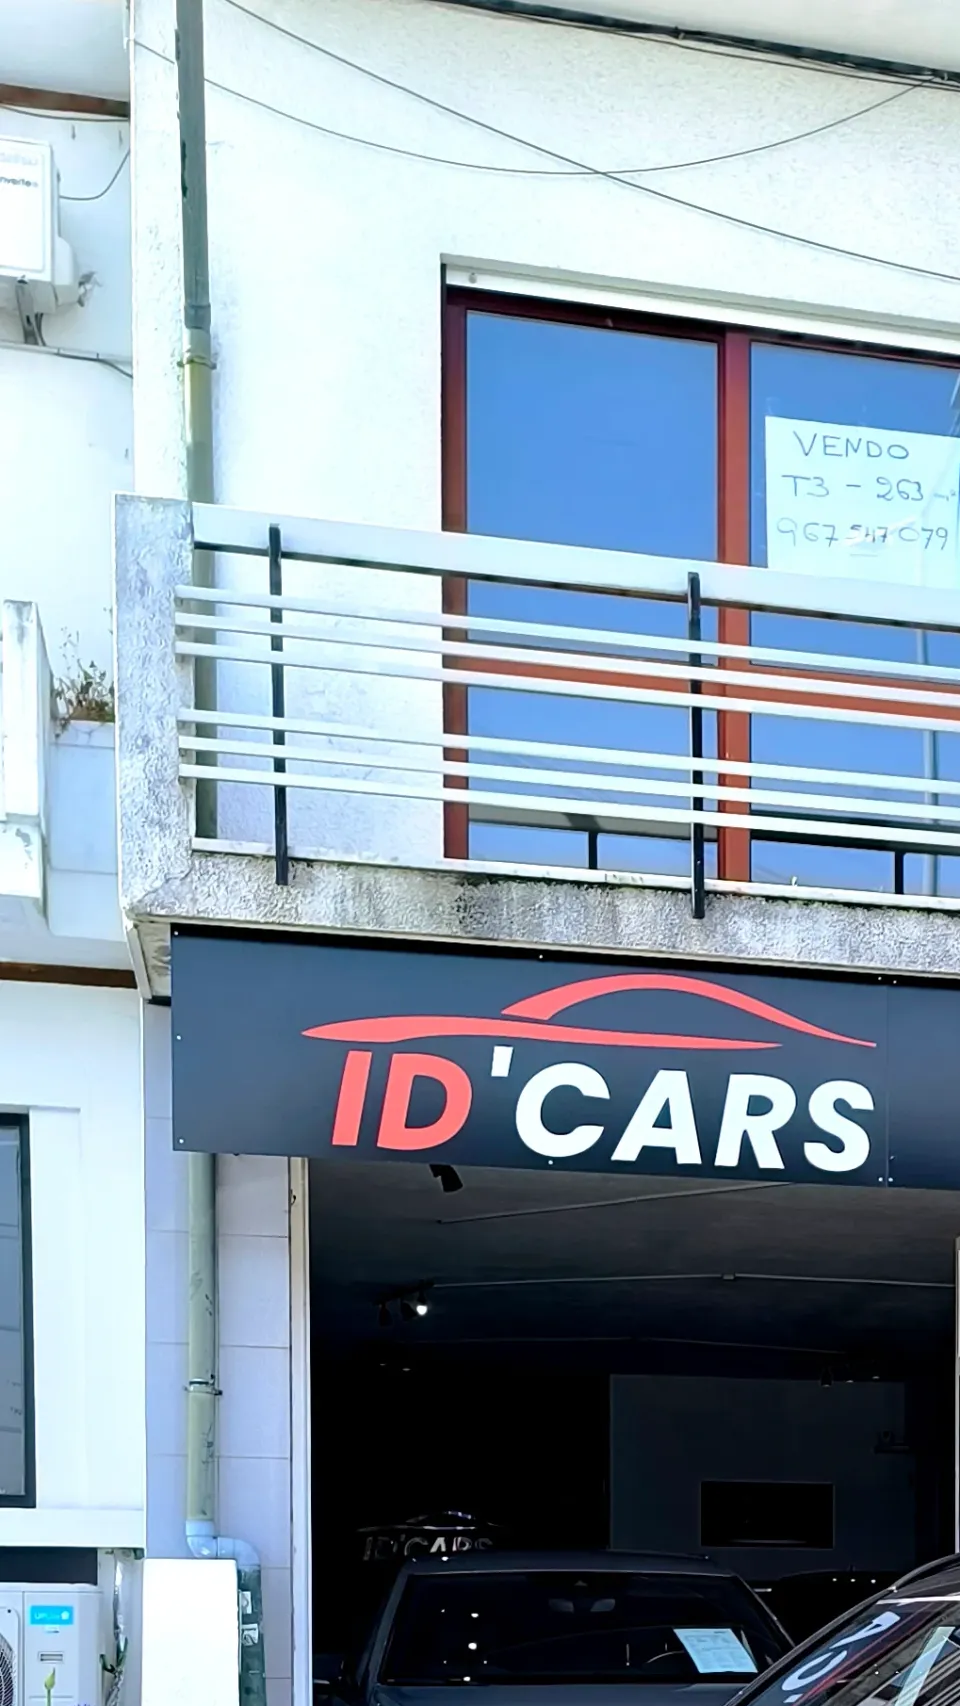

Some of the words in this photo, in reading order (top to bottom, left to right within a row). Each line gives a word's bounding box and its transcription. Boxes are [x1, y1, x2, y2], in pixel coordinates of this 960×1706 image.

[793, 430, 910, 460] VENDO
[780, 474, 830, 498] T3
[875, 476, 924, 502] 263
[776, 517, 839, 548] 967
[898, 526, 949, 551] 079
